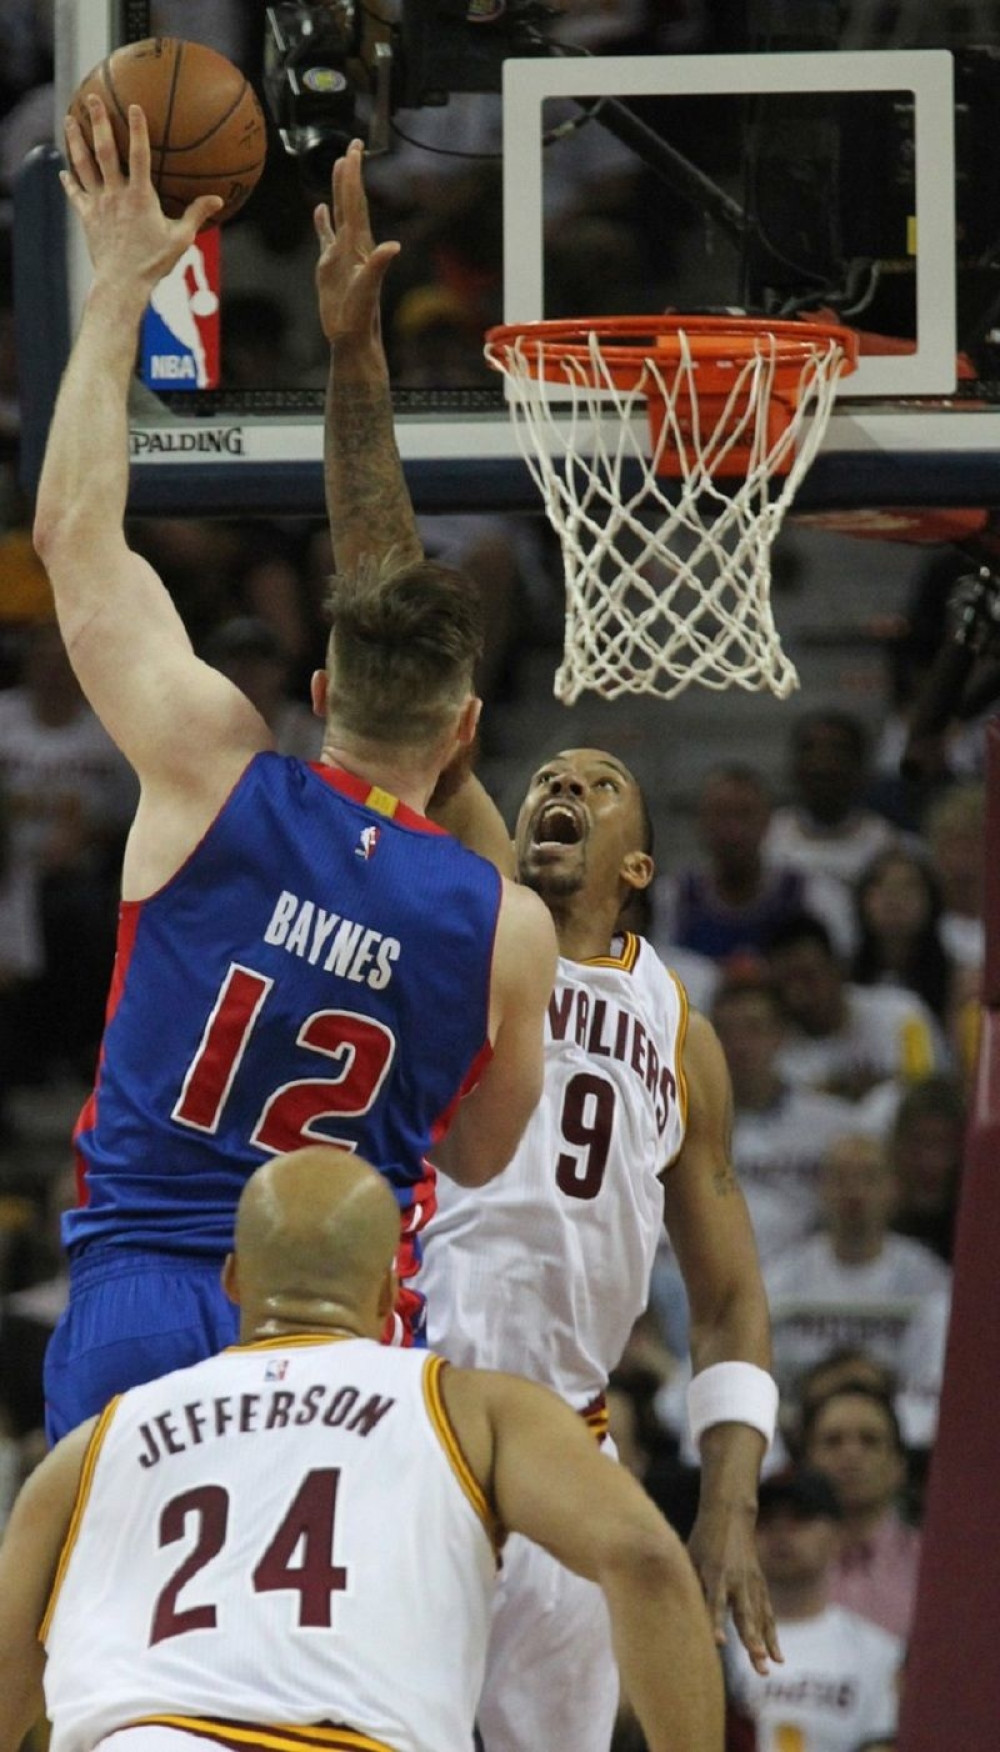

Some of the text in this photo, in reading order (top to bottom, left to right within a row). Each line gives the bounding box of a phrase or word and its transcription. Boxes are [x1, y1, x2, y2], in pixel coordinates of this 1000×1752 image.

[150, 355, 196, 379] NBA
[129, 427, 245, 456] PALDING
[263, 889, 401, 990] BAYNES
[171, 962, 396, 1154] 12
[547, 988, 676, 1136] VALIERS
[555, 1072, 616, 1199] 9
[138, 1385, 395, 1469] JEFFERSON
[149, 1467, 347, 1647] 24
